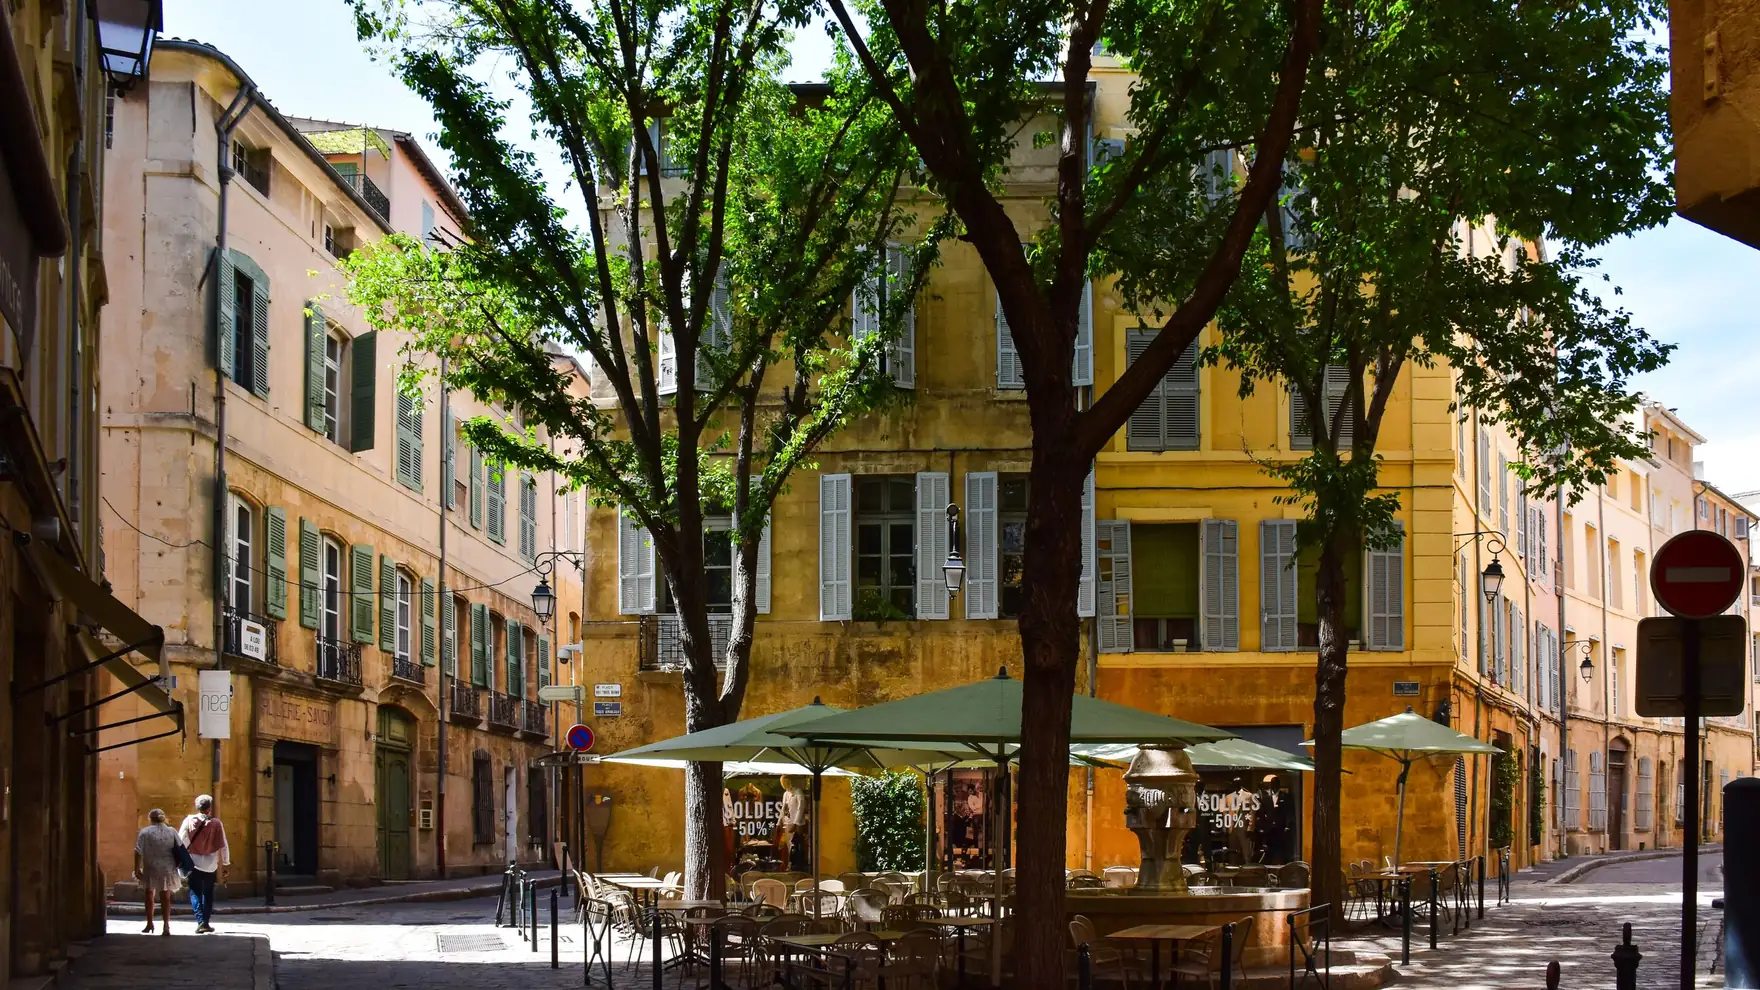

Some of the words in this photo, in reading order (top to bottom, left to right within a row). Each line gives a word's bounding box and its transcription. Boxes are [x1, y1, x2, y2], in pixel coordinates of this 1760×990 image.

[201, 694, 229, 712] nea
[722, 801, 783, 819] SOLDES
[1200, 793, 1261, 812] SOLDES
